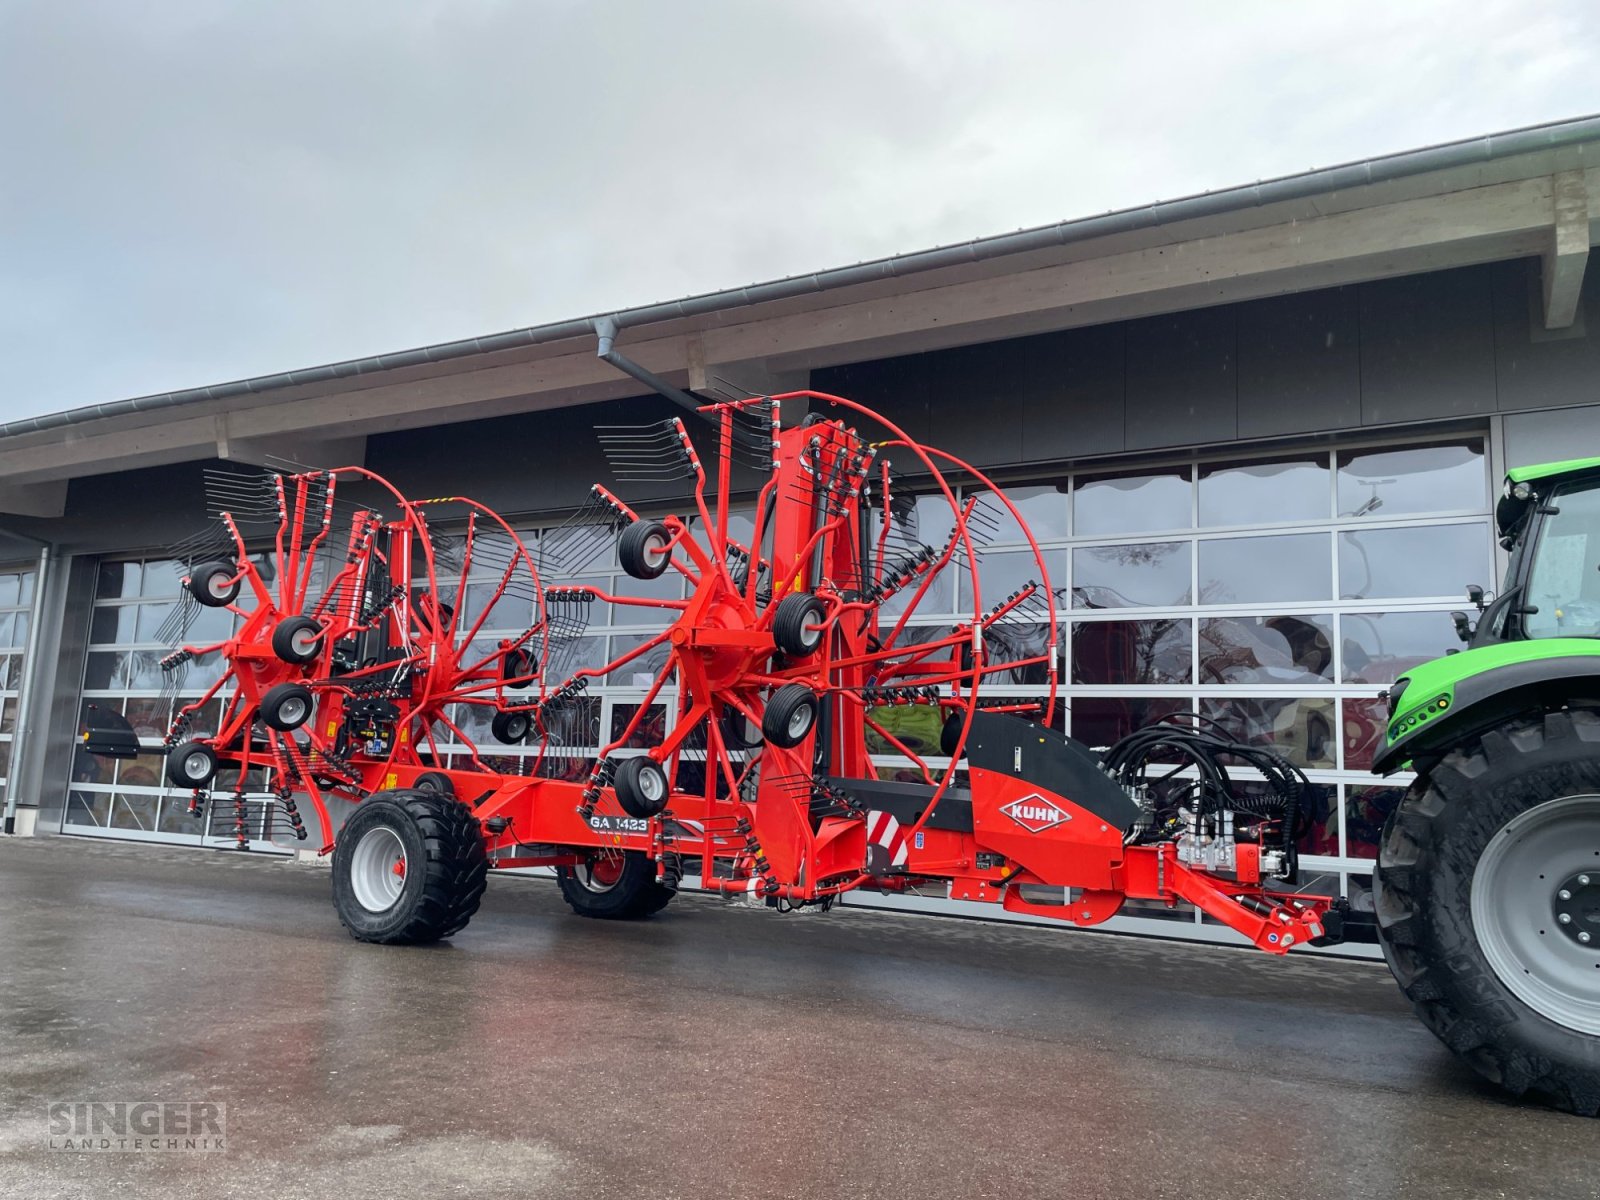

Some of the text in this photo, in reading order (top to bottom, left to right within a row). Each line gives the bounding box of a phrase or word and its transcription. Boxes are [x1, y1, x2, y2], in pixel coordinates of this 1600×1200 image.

[1011, 804, 1059, 822] KUHN
[590, 816, 650, 831] GA 1423
